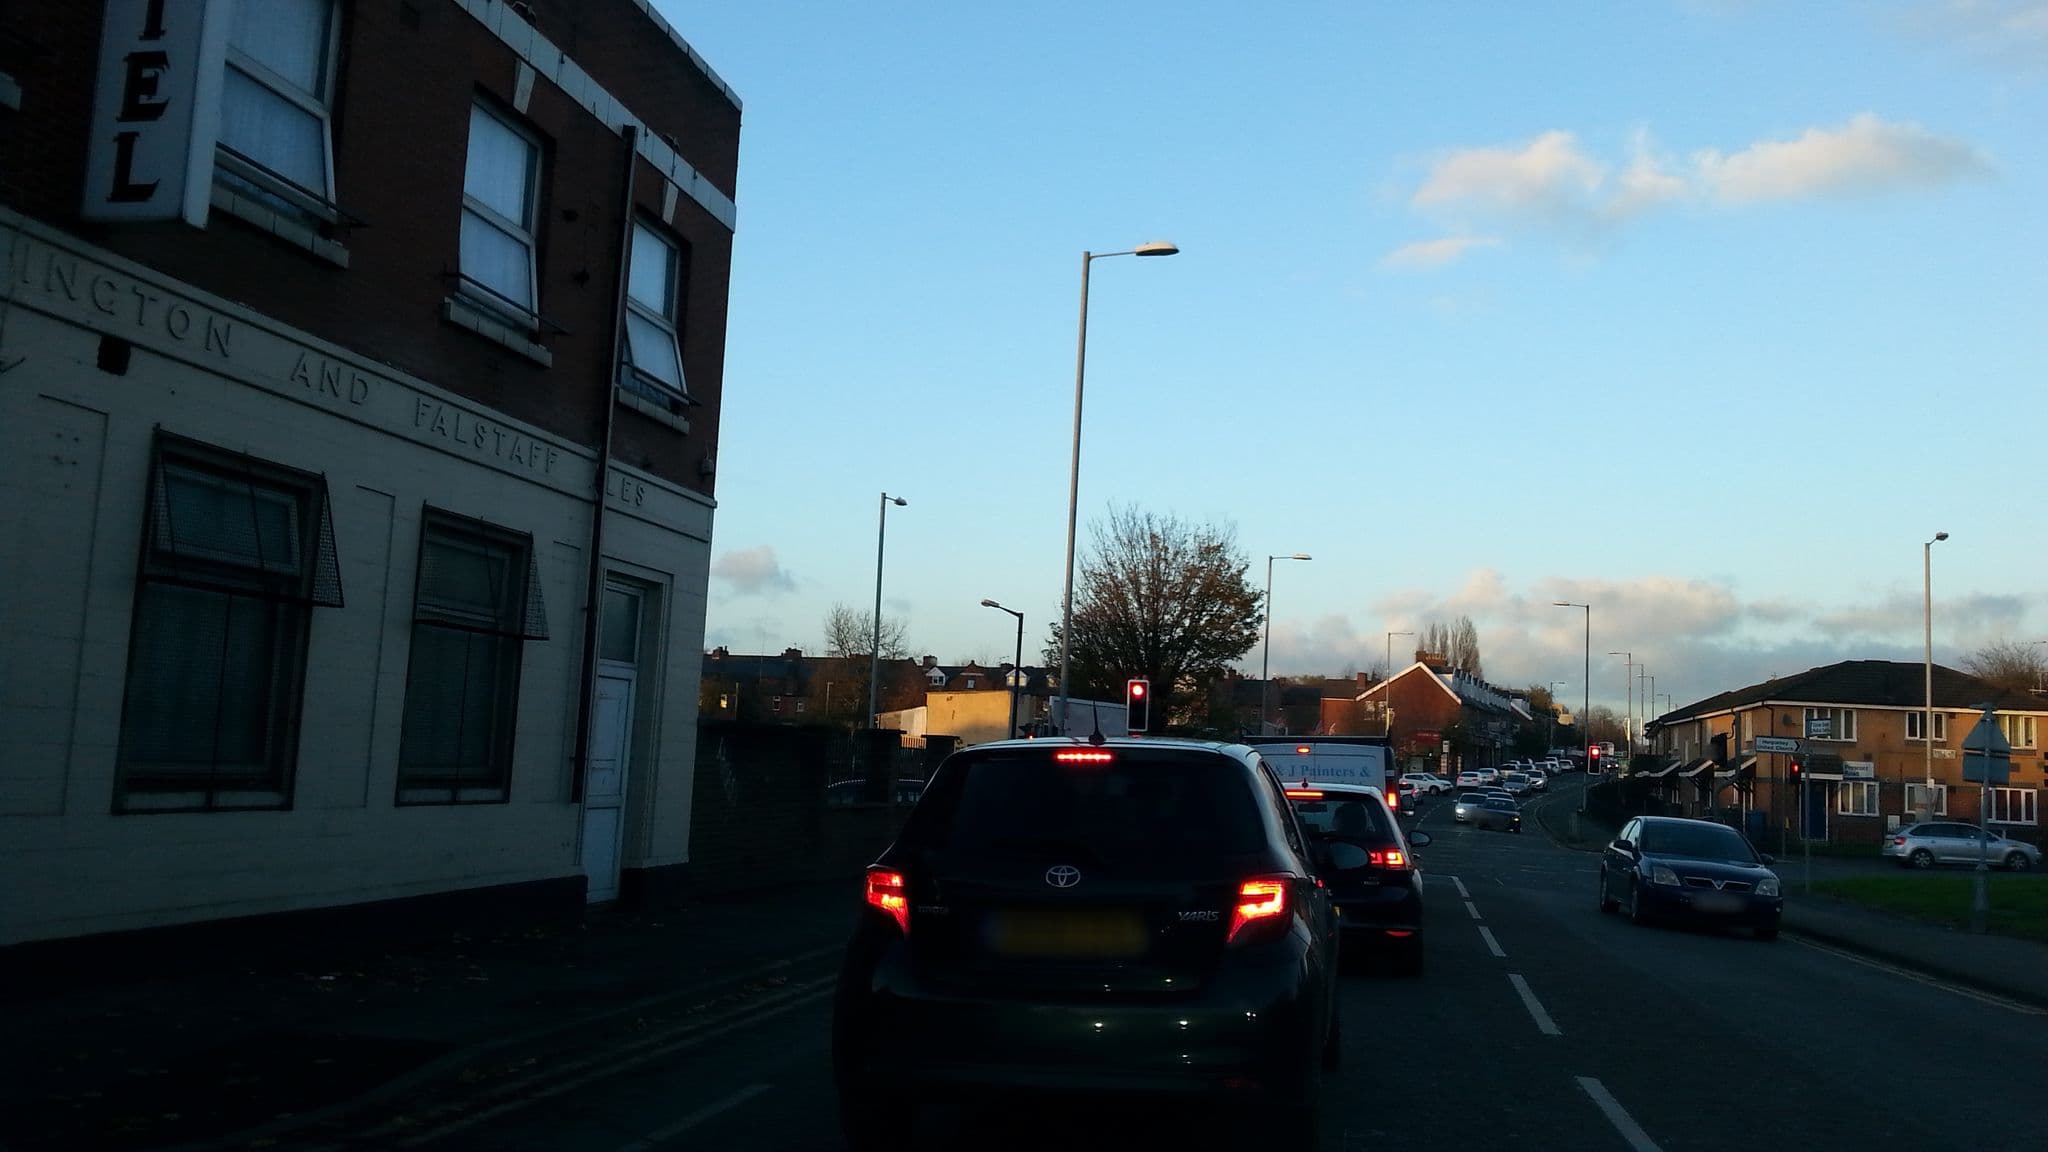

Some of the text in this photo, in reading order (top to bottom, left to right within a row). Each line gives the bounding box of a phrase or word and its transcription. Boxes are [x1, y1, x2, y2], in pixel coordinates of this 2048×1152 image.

[290, 351, 369, 406] AND
[414, 396, 557, 474] FALSTAFF
[1288, 765, 1295, 777] J
[1301, 765, 1355, 777] Painters
[1360, 766, 1370, 778] &
[1178, 911, 1219, 921] YARIS
